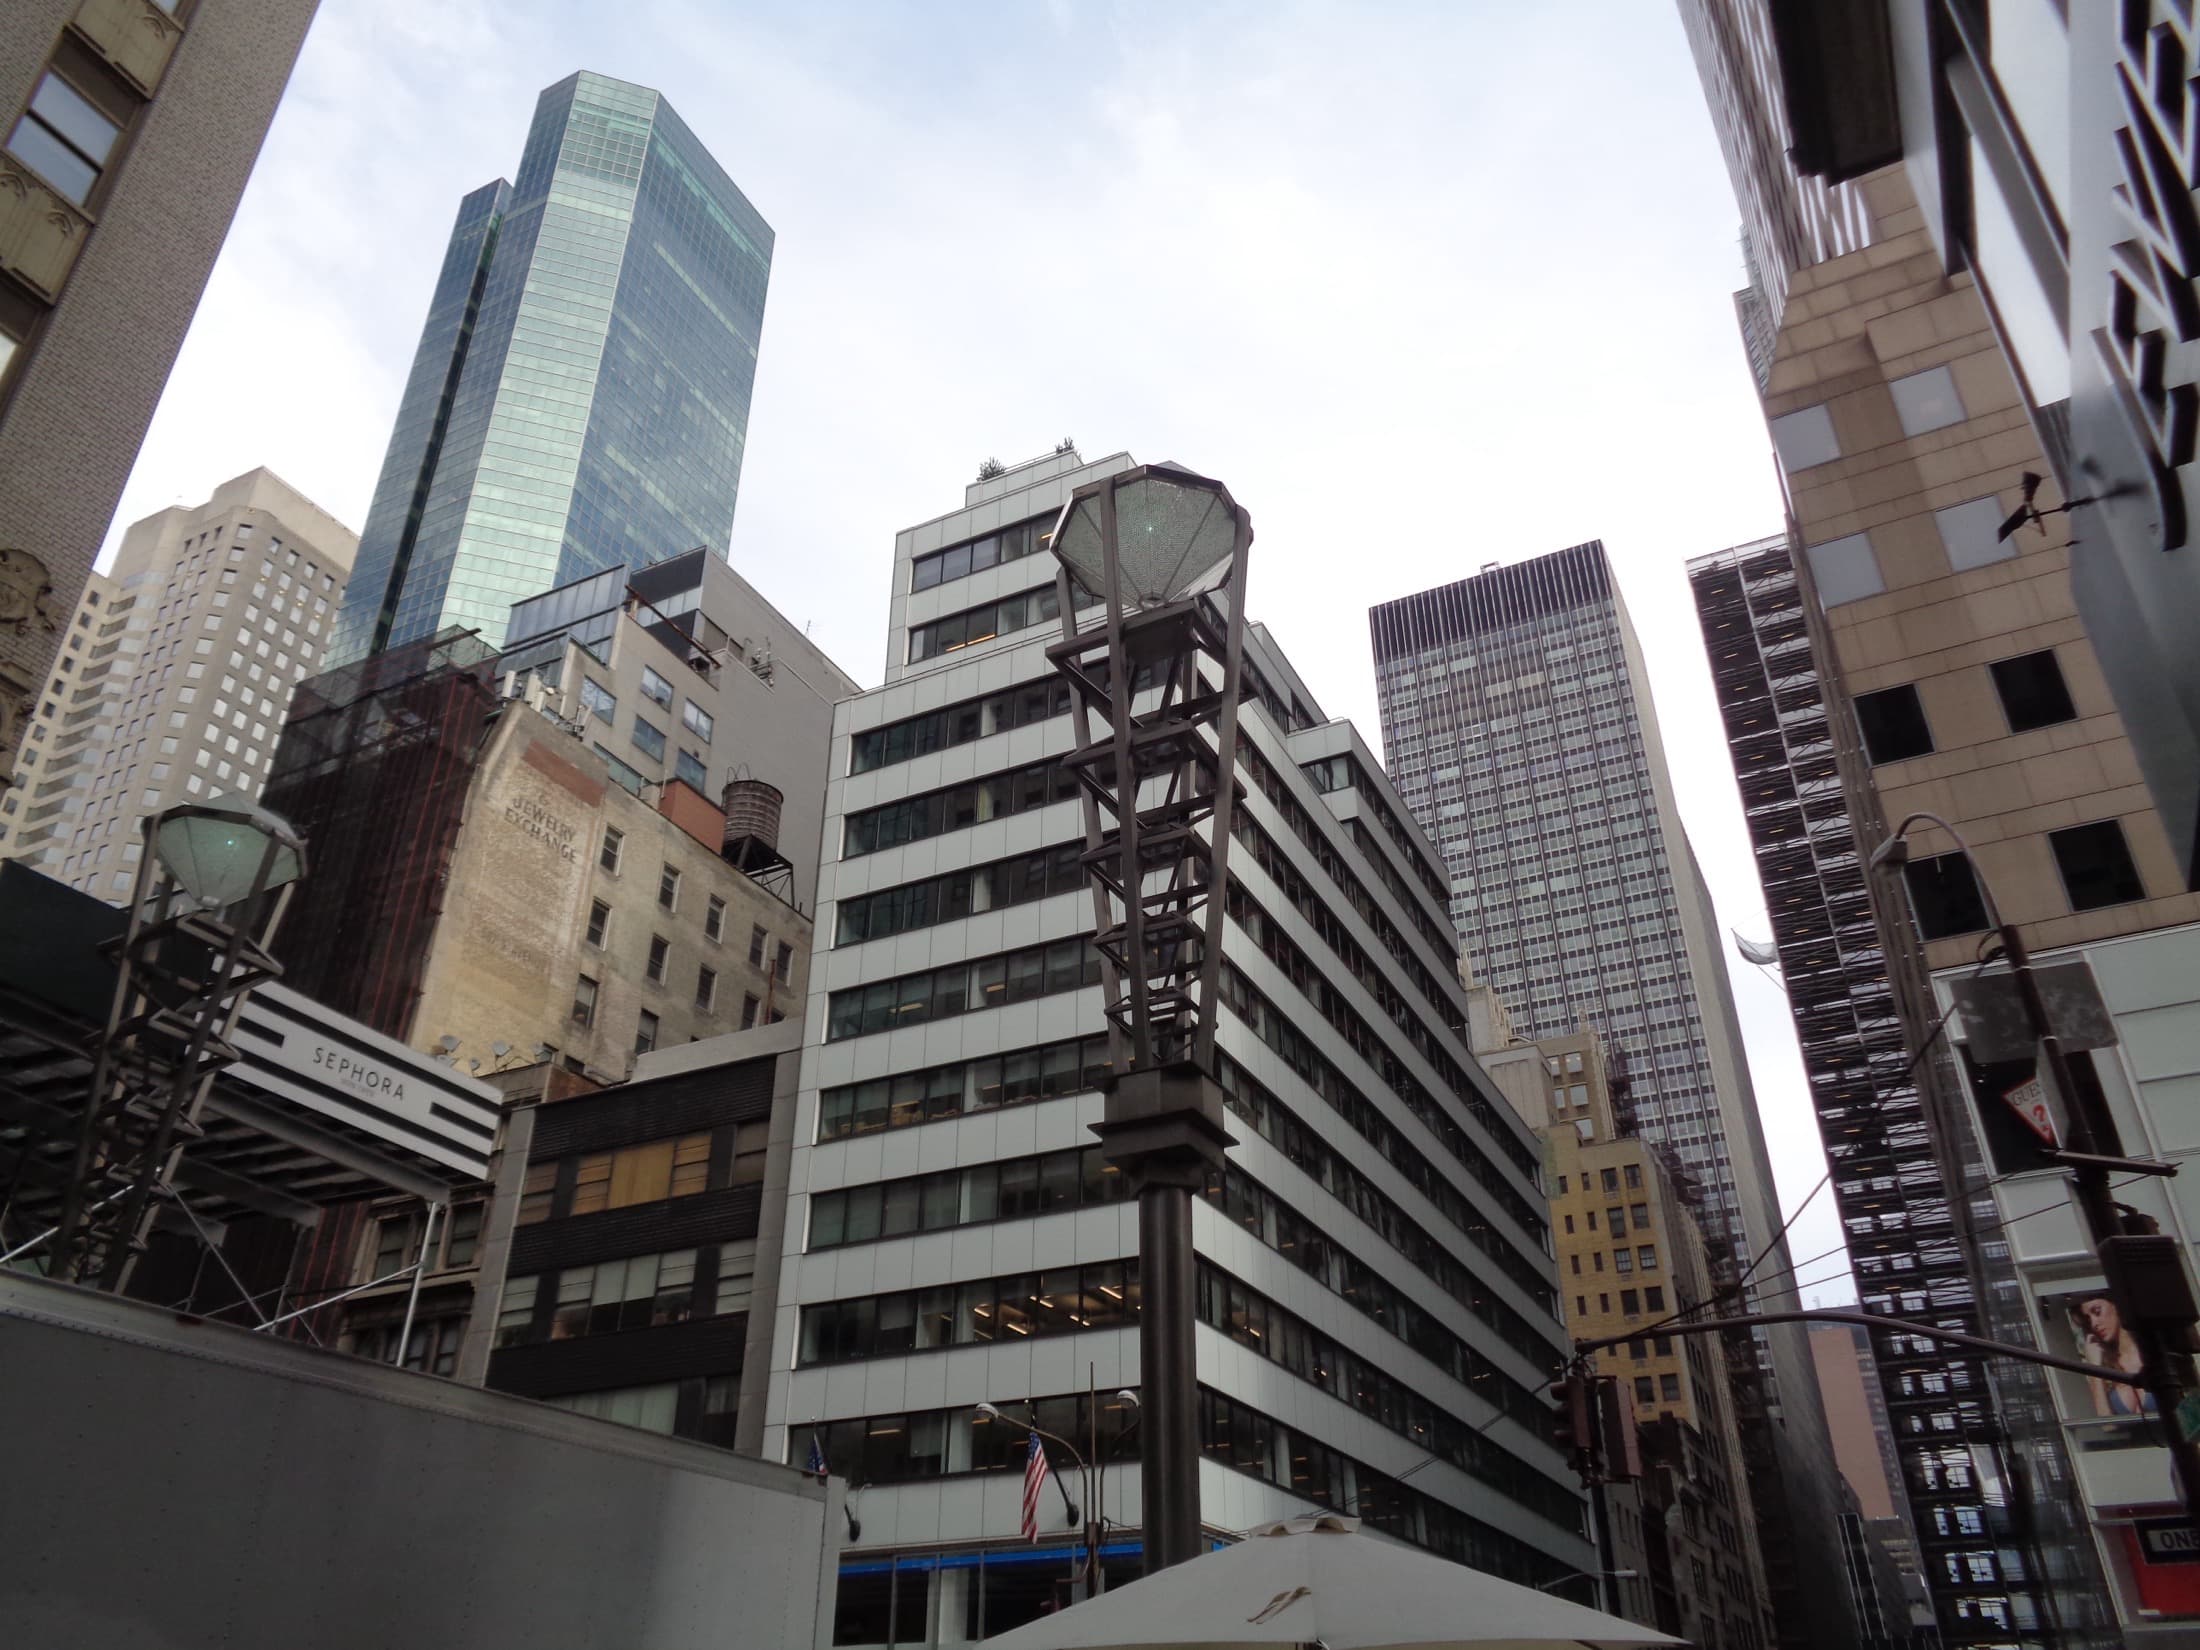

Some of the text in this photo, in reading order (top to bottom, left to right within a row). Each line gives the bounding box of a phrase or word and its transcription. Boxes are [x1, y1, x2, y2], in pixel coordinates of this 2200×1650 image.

[504, 807, 577, 865] EXCHANGE
[512, 797, 576, 842] JEWELRY
[312, 1047, 404, 1101] SEPHORA
